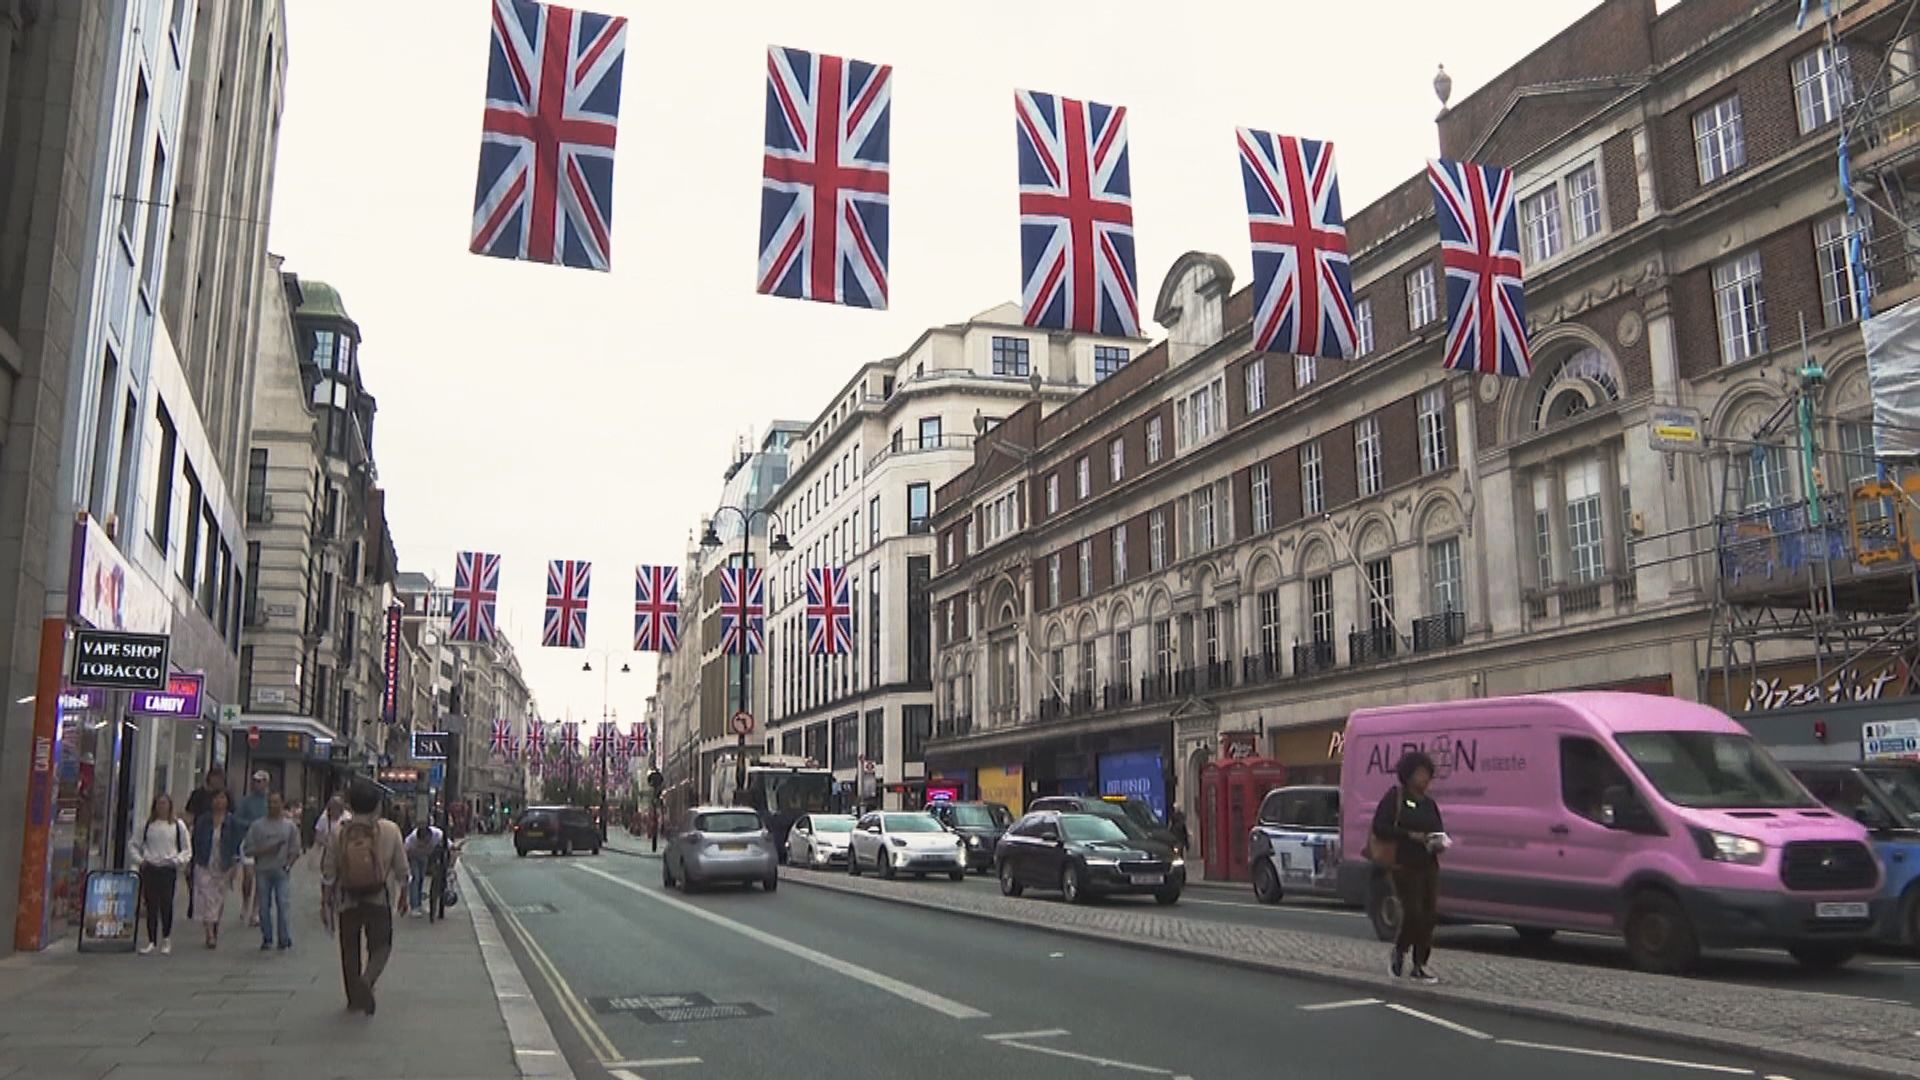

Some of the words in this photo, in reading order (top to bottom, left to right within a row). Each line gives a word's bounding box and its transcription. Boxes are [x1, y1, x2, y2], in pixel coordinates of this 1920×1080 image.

[84, 642, 120, 655] VAPE
[122, 644, 161, 658] SHOP
[82, 662, 159, 679] TOBACCO
[1744, 678, 1820, 711] Pizza
[1829, 669, 1896, 703] Hut
[145, 696, 185, 712] CANDY
[96, 920, 124, 936] SHOP
